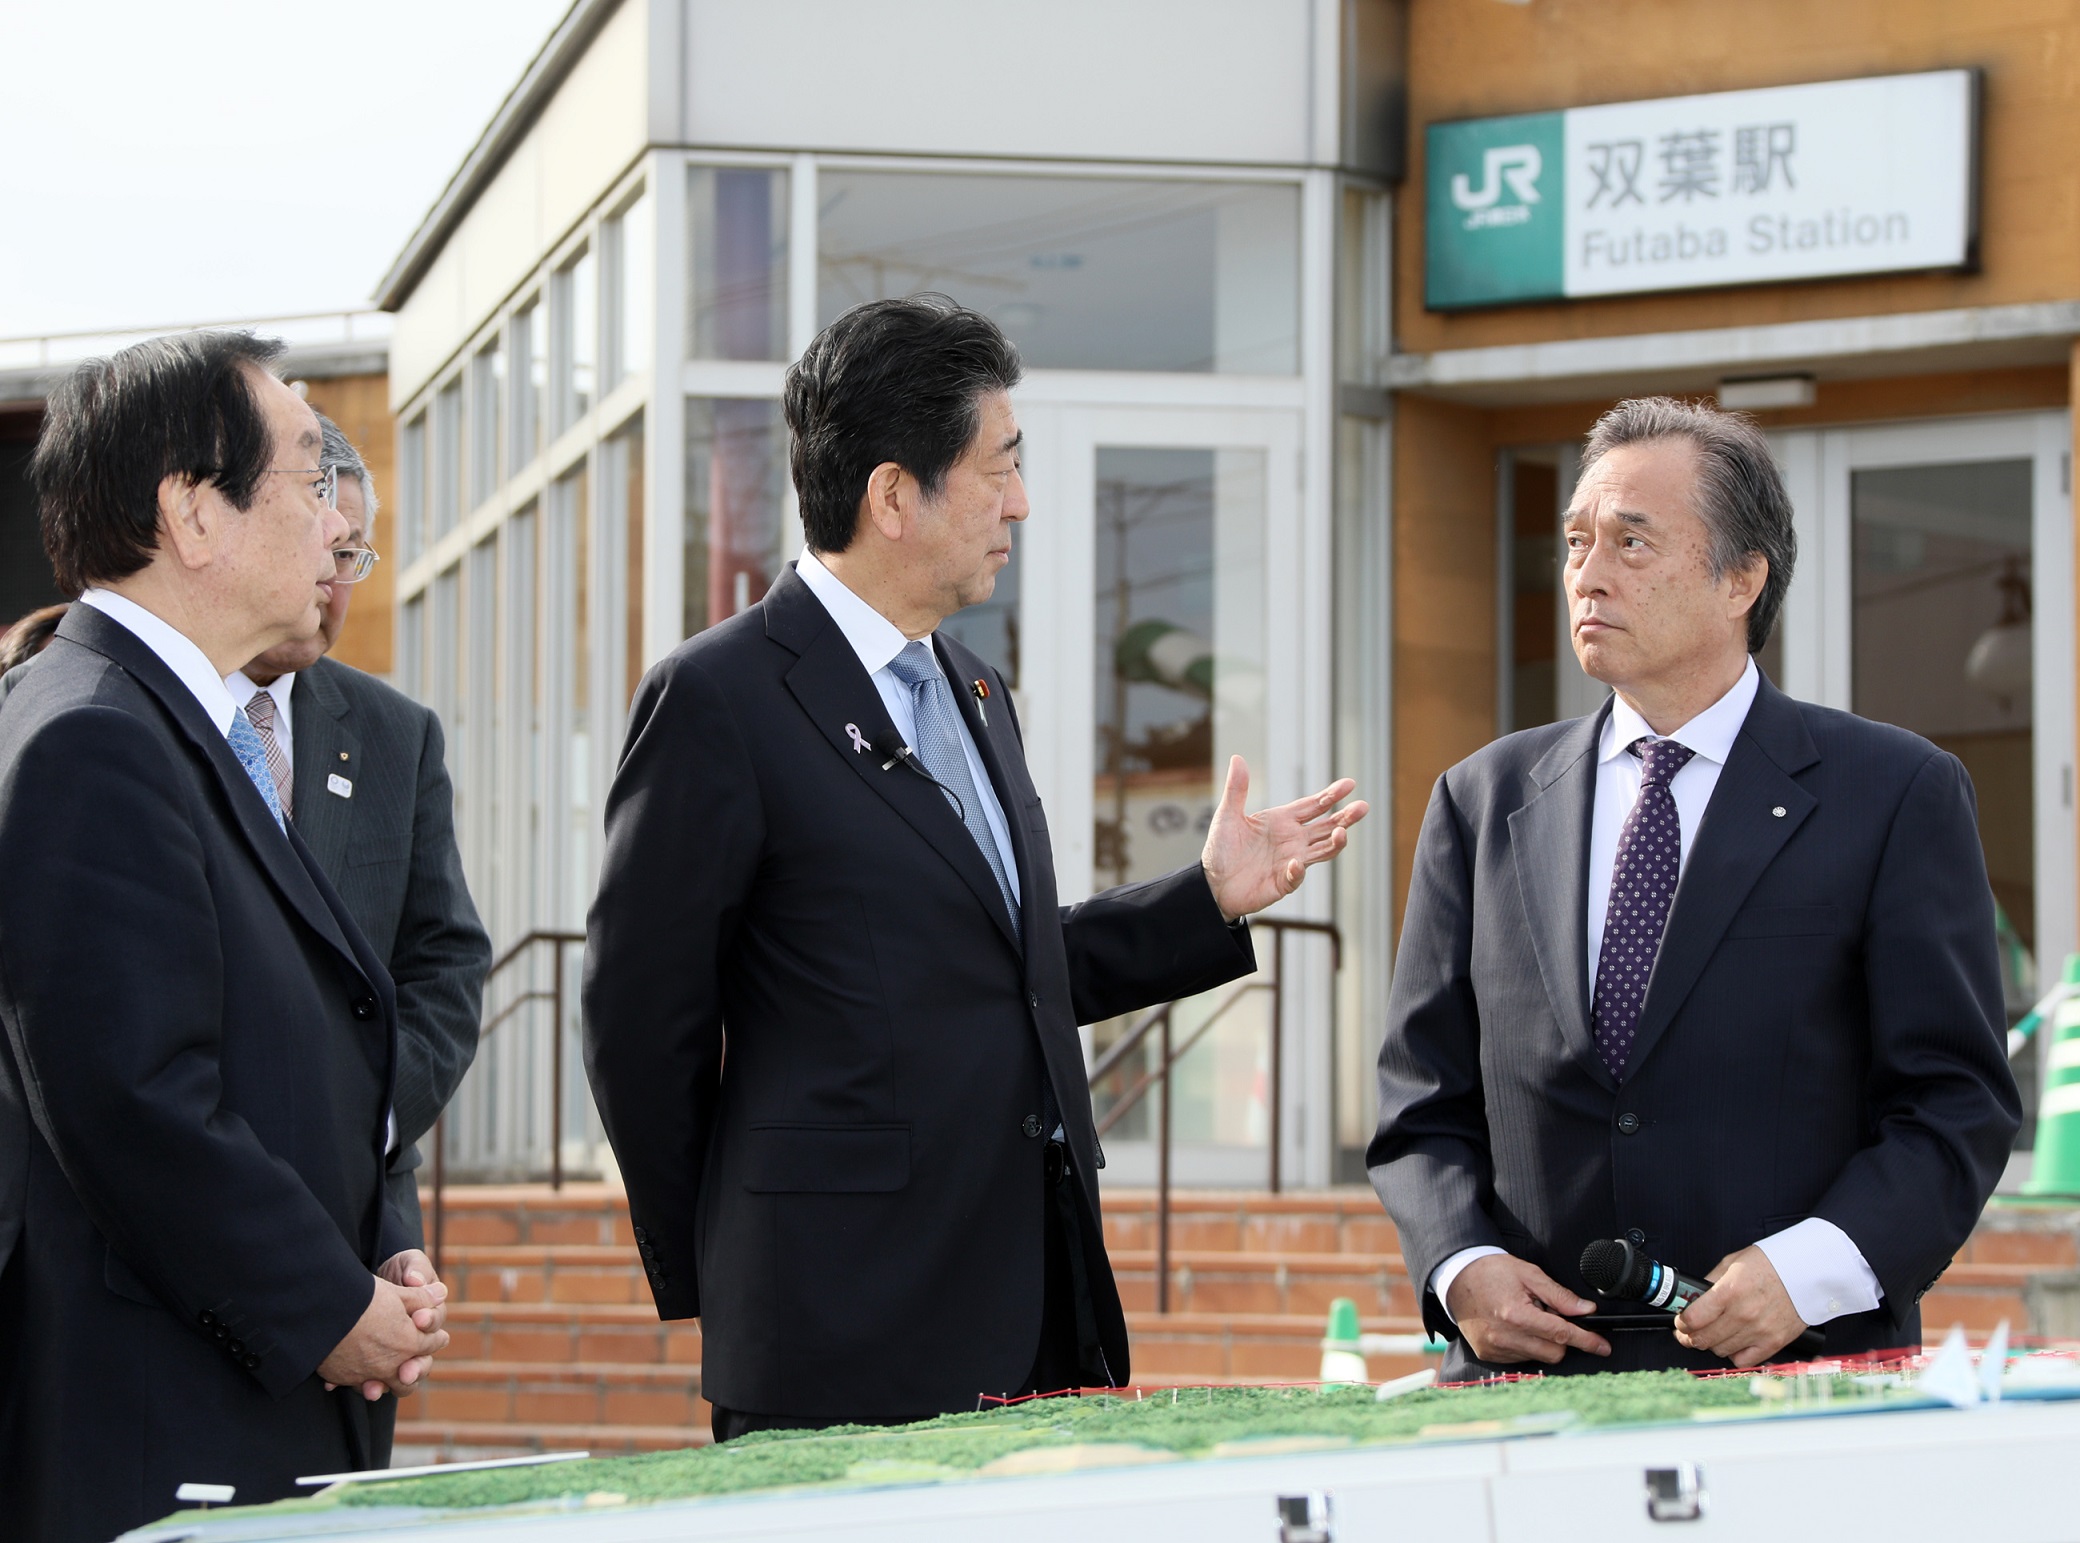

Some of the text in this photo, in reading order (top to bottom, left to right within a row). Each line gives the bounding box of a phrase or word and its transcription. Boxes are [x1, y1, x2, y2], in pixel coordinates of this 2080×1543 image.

[1451, 144, 1542, 211] JR
[1586, 122, 1797, 209] 双葉駅
[1581, 206, 1911, 268] Futaba Station
